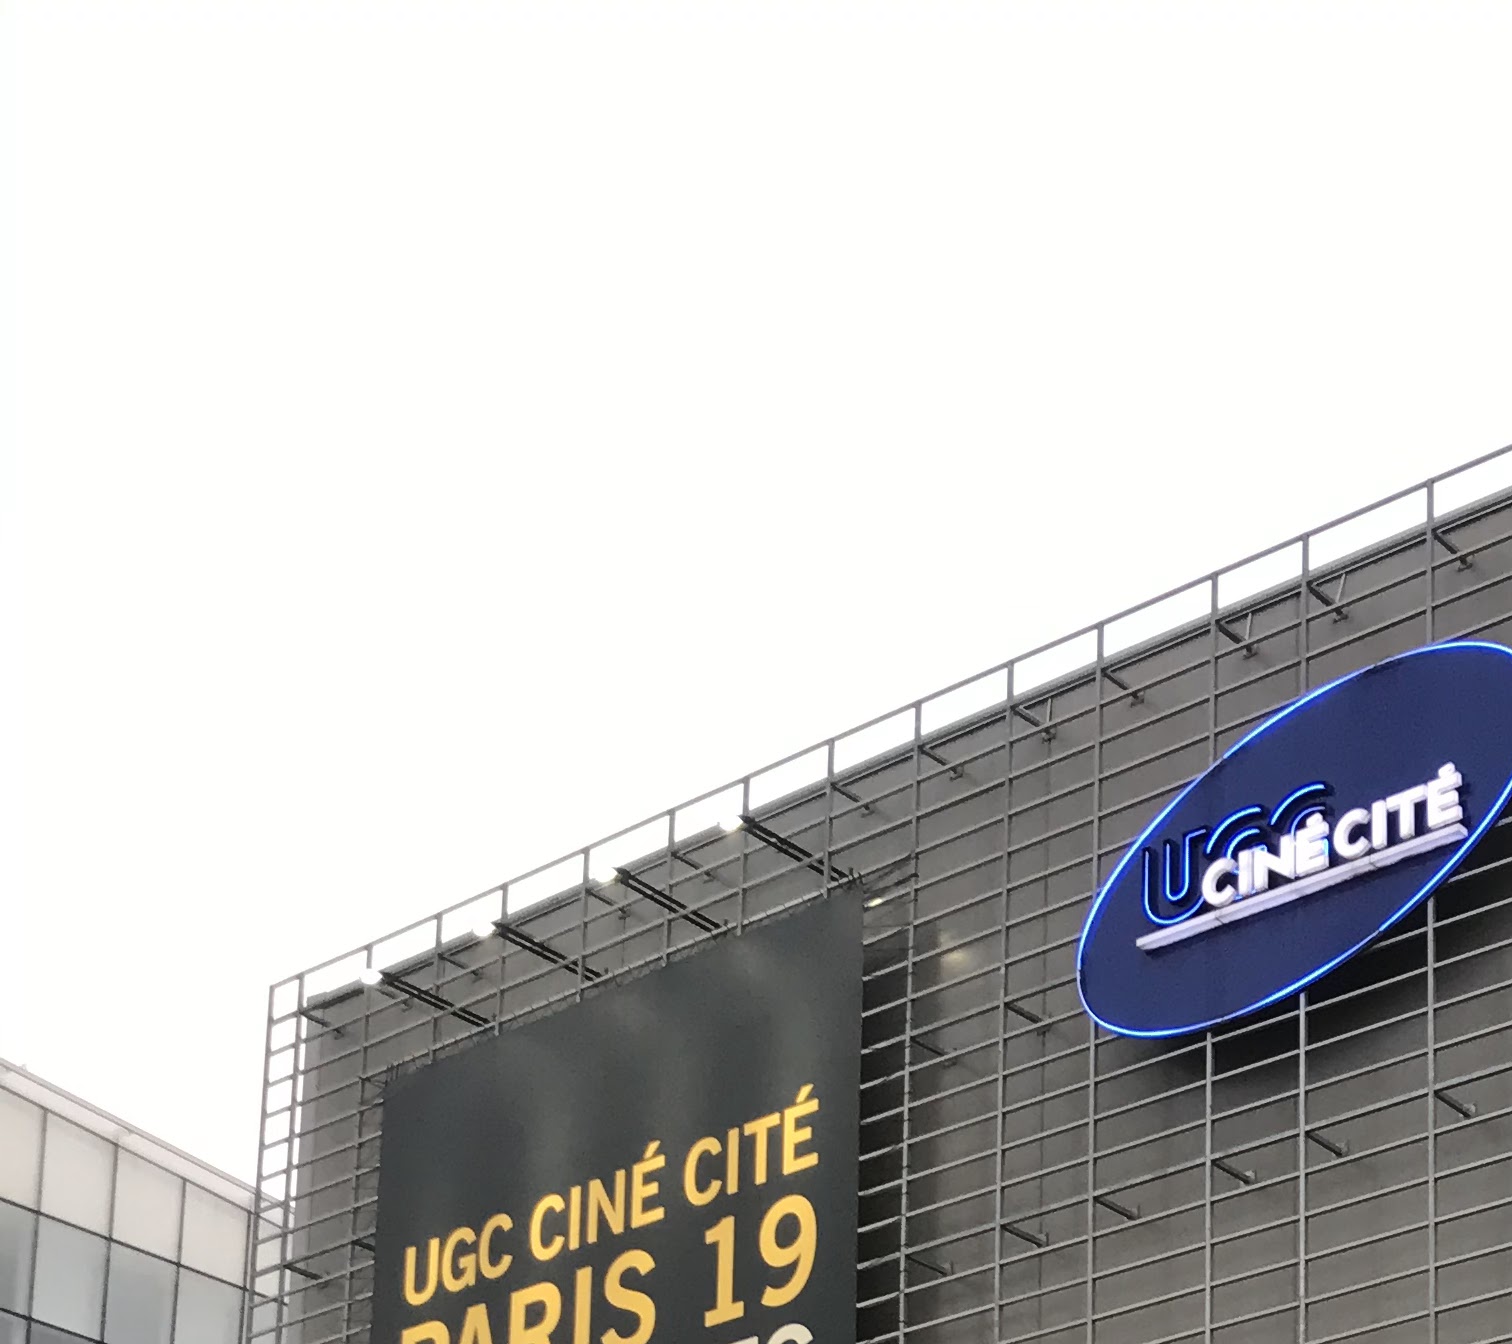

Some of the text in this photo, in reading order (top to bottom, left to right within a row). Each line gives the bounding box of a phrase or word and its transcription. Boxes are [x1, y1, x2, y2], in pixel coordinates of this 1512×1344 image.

[1203, 762, 1462, 906] CINÉ CITÉ
[404, 1085, 818, 1304] UGC CINÉ CITÉ
[703, 1195, 817, 1327] 19
